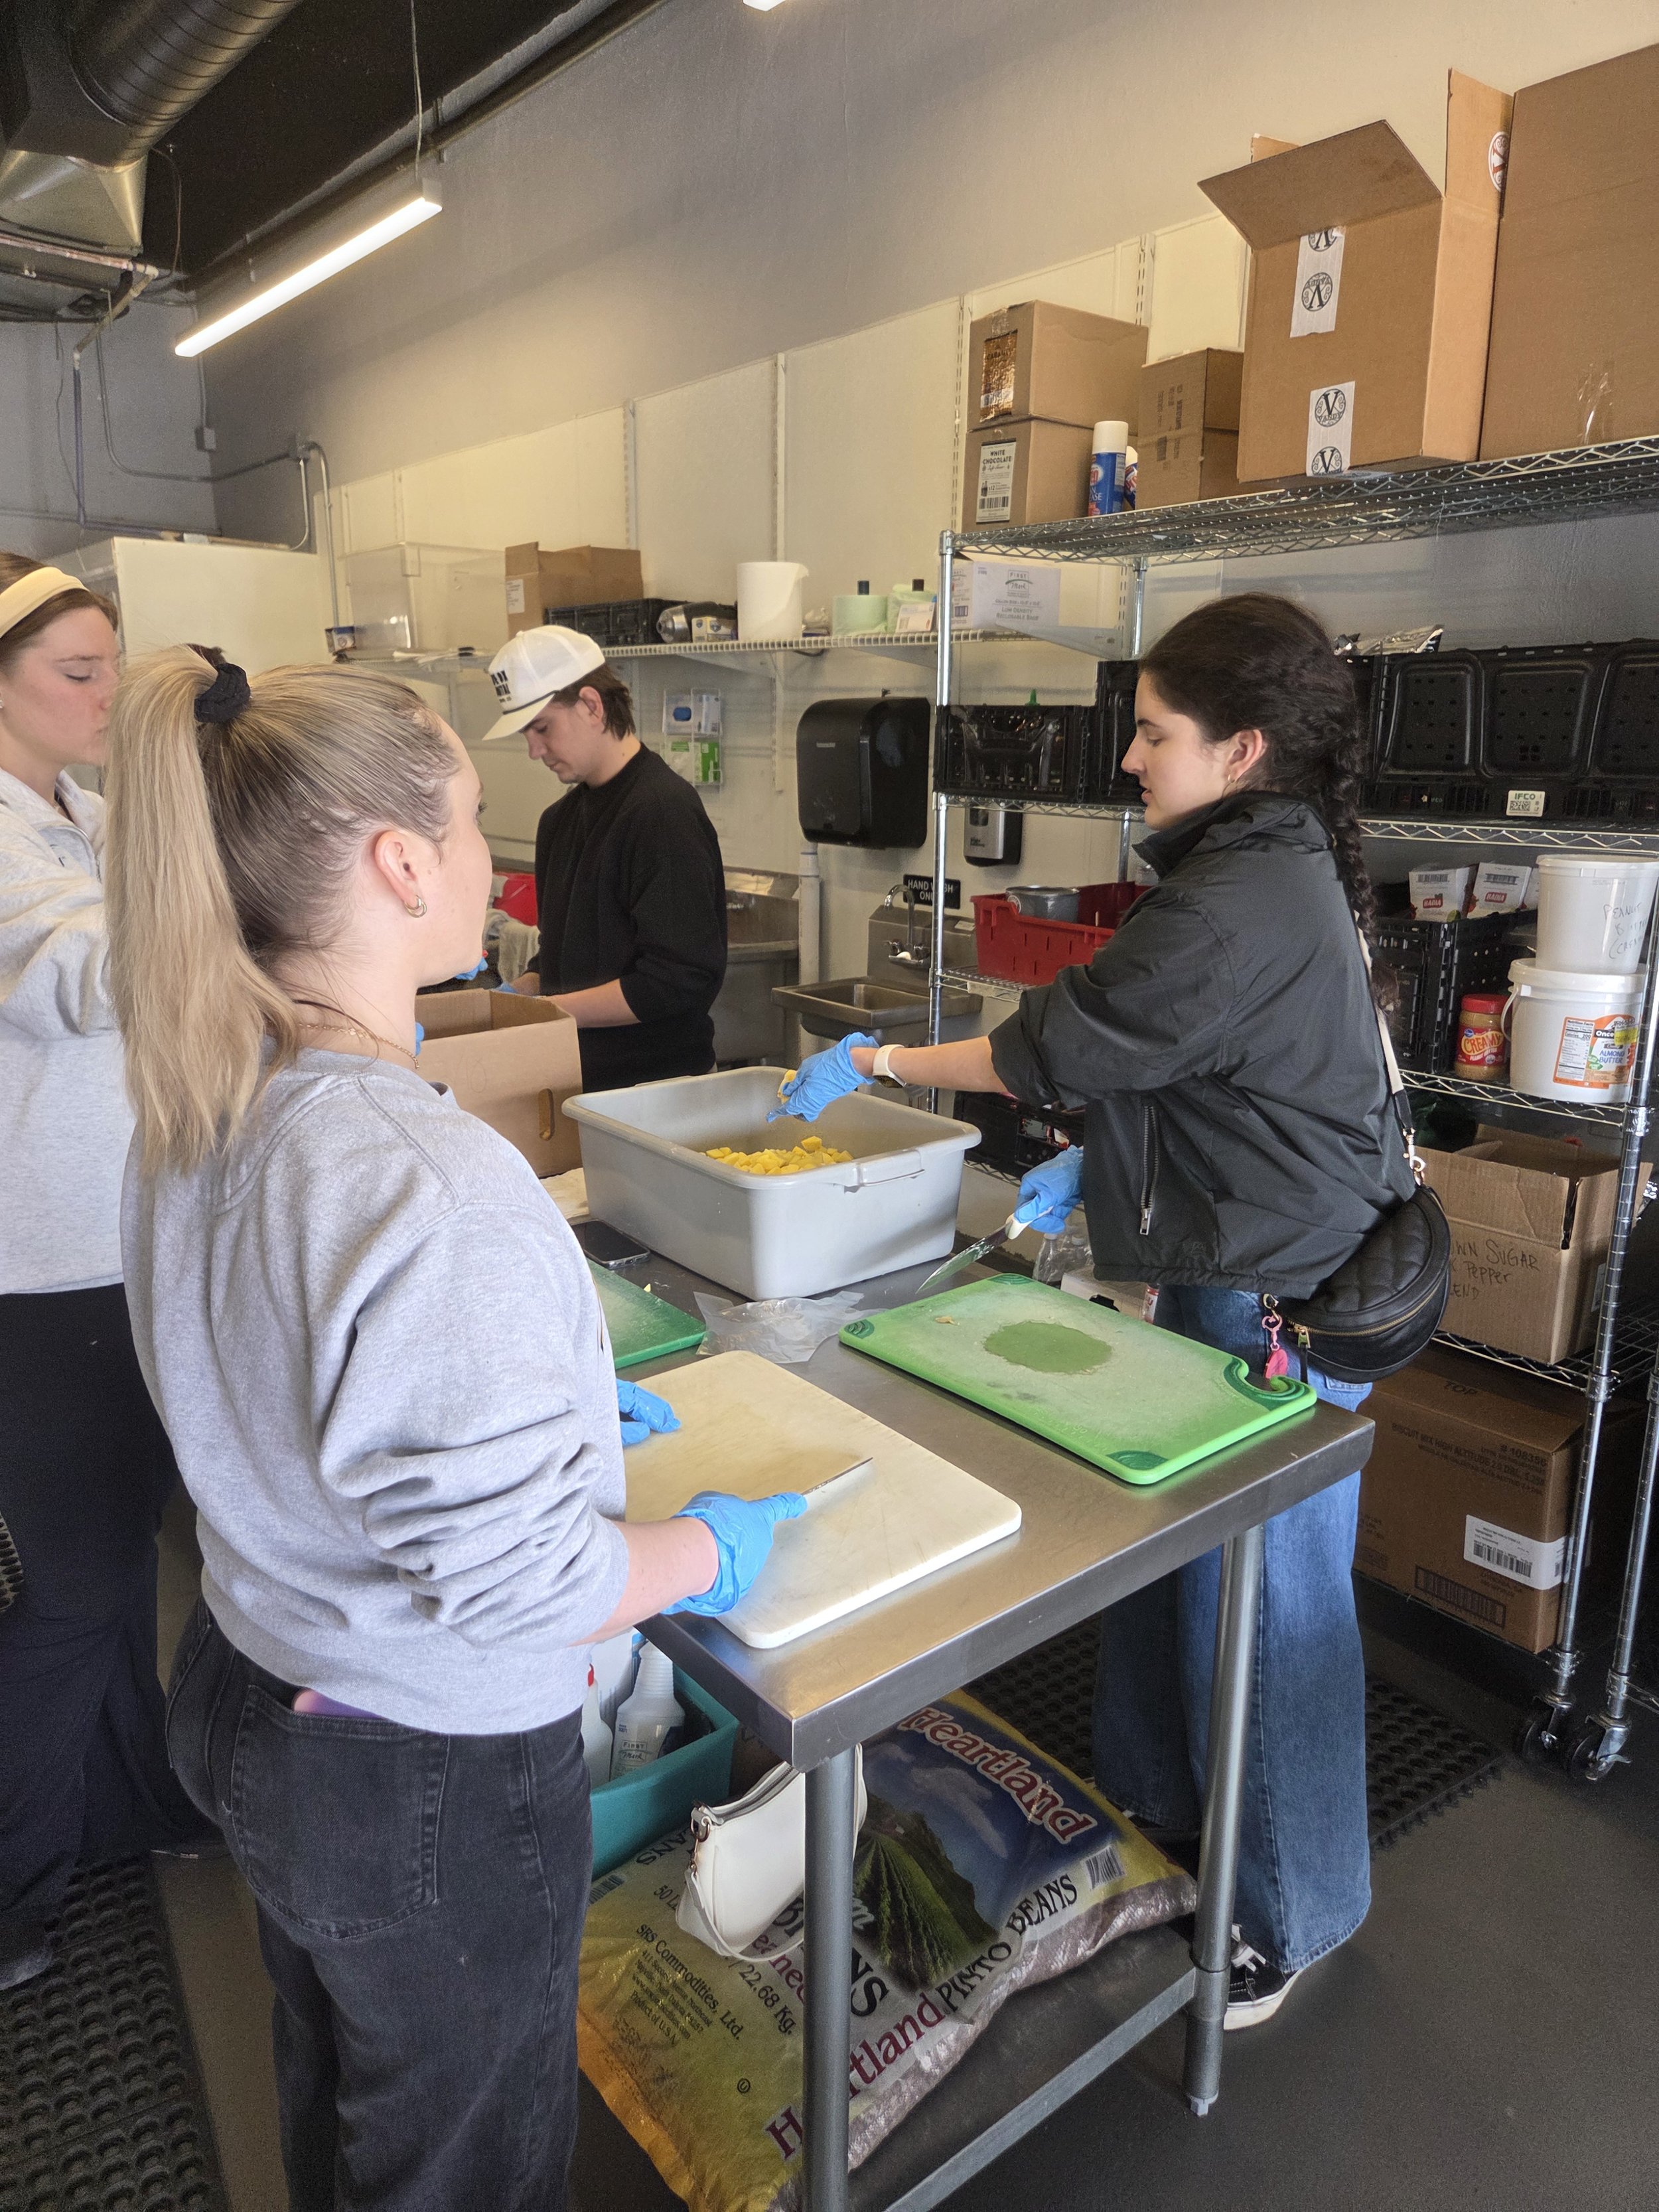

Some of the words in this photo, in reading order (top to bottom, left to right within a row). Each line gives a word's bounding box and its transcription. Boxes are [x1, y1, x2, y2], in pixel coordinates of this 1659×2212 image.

[1323, 391, 1340, 415] V
[982, 456, 1012, 465] CHOCOLATE
[908, 879, 929, 891] HAND
[1464, 1033, 1502, 1054] CREAMY
[1486, 1238, 1540, 1272] SUGAR
[1444, 1380, 1478, 1395] TOP
[897, 1707, 1098, 1845] Heartland
[653, 1885, 673, 1899] 50
[739, 1963, 780, 2008] 22.68
[774, 2004, 796, 2035] Kg.
[934, 1941, 1012, 2014] PINTO
[1005, 1873, 1078, 1937] BEANS
[636, 1924, 658, 1944] SRS
[655, 1939, 719, 2014] Commodities,
[719, 2009, 744, 2040] Ltd.
[630, 1989, 653, 2018] Product
[650, 2014, 662, 2026] of
